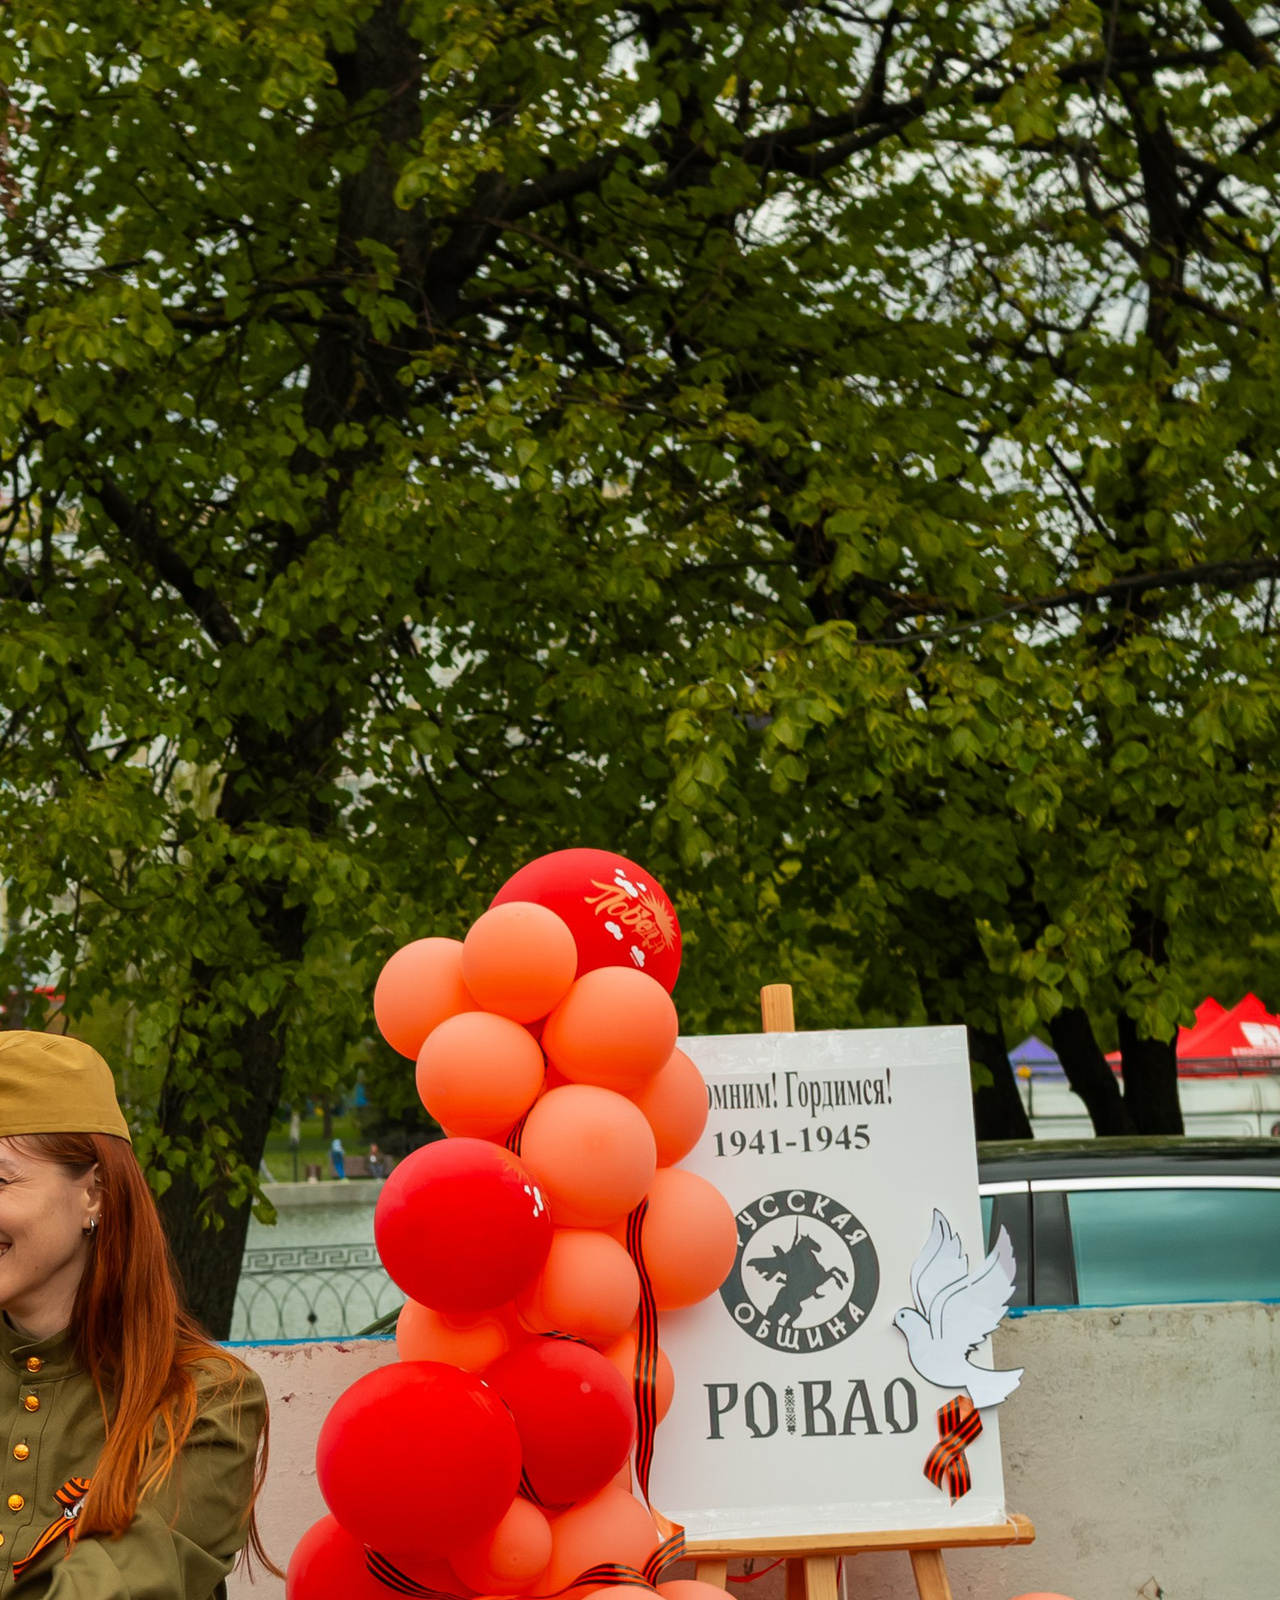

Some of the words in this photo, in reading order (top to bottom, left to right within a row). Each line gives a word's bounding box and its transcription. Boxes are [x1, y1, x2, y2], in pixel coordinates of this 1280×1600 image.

[784, 1067, 893, 1118] Гордимся!
[713, 1124, 871, 1157] 1941-1945
[736, 1190, 868, 1247] УССКАЯ
[734, 1301, 865, 1350] ОБЩИНА
